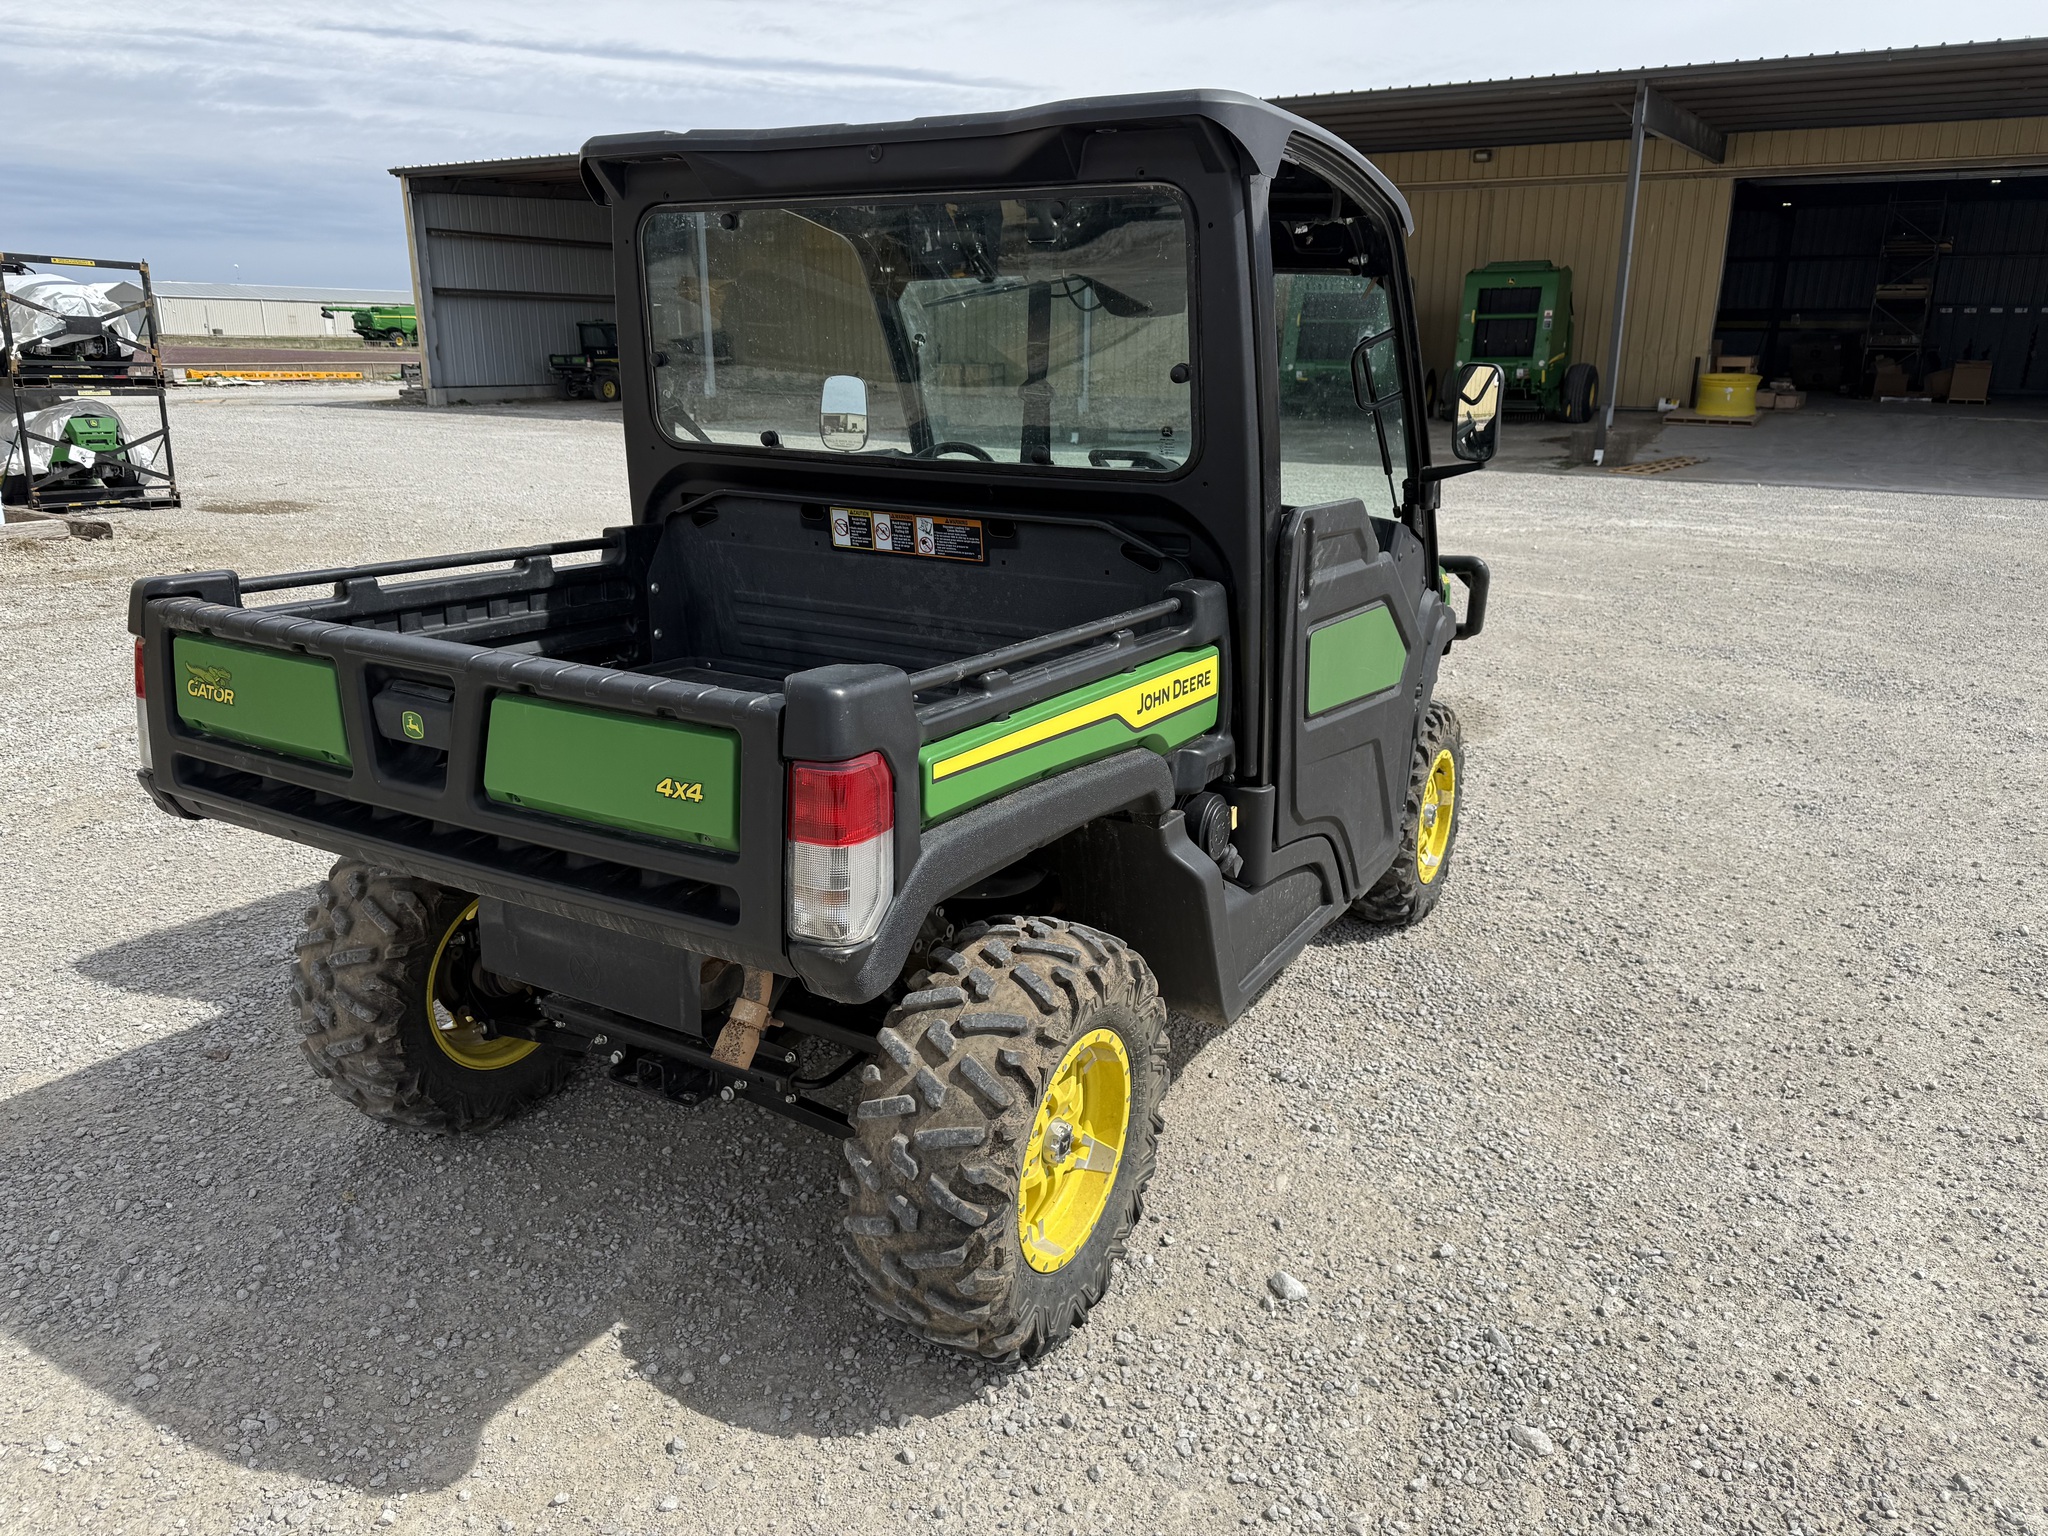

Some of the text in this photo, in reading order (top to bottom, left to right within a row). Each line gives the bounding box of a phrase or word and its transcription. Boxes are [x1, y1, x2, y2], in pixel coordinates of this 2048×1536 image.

[187, 678, 235, 705] GATOR
[1137, 670, 1211, 715] JOHN DEERE
